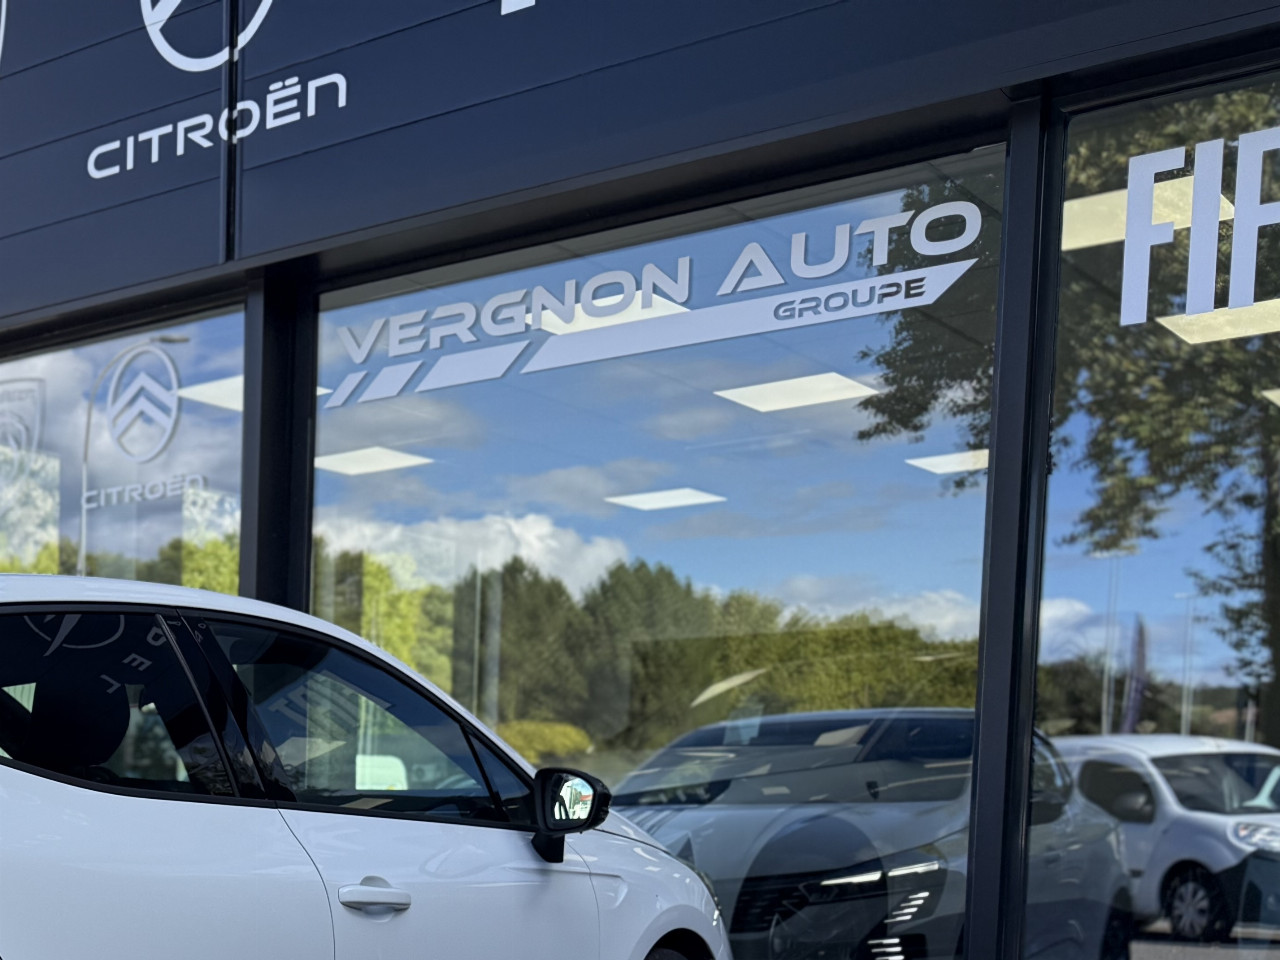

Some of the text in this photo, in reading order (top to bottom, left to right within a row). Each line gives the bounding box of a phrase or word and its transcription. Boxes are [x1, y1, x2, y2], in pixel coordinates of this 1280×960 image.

[338, 201, 982, 364] VERGNON AUTO
[774, 276, 927, 321] GROUPE
